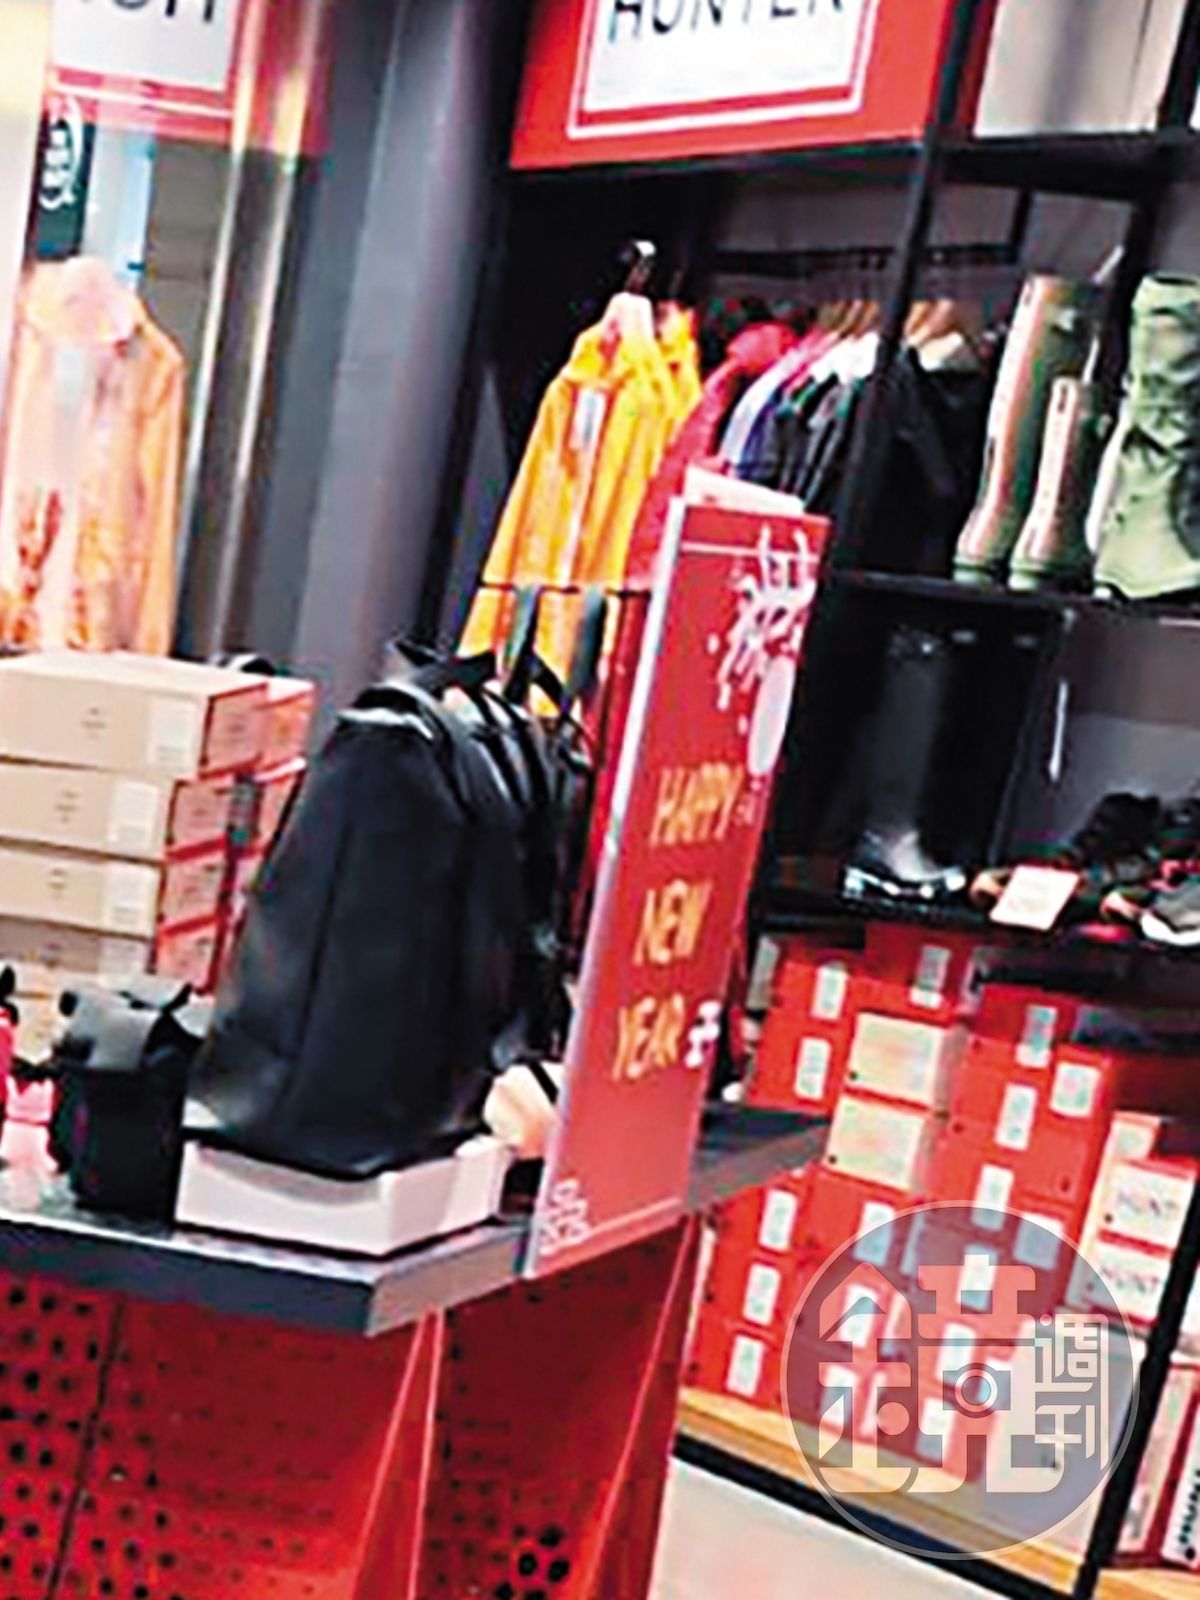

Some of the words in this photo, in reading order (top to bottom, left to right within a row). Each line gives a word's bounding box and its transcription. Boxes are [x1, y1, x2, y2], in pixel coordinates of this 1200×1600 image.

[606, 0, 844, 43] HUN
[650, 761, 745, 845] HAPPY
[633, 878, 712, 966] NEW
[612, 993, 685, 1082] YEAR
